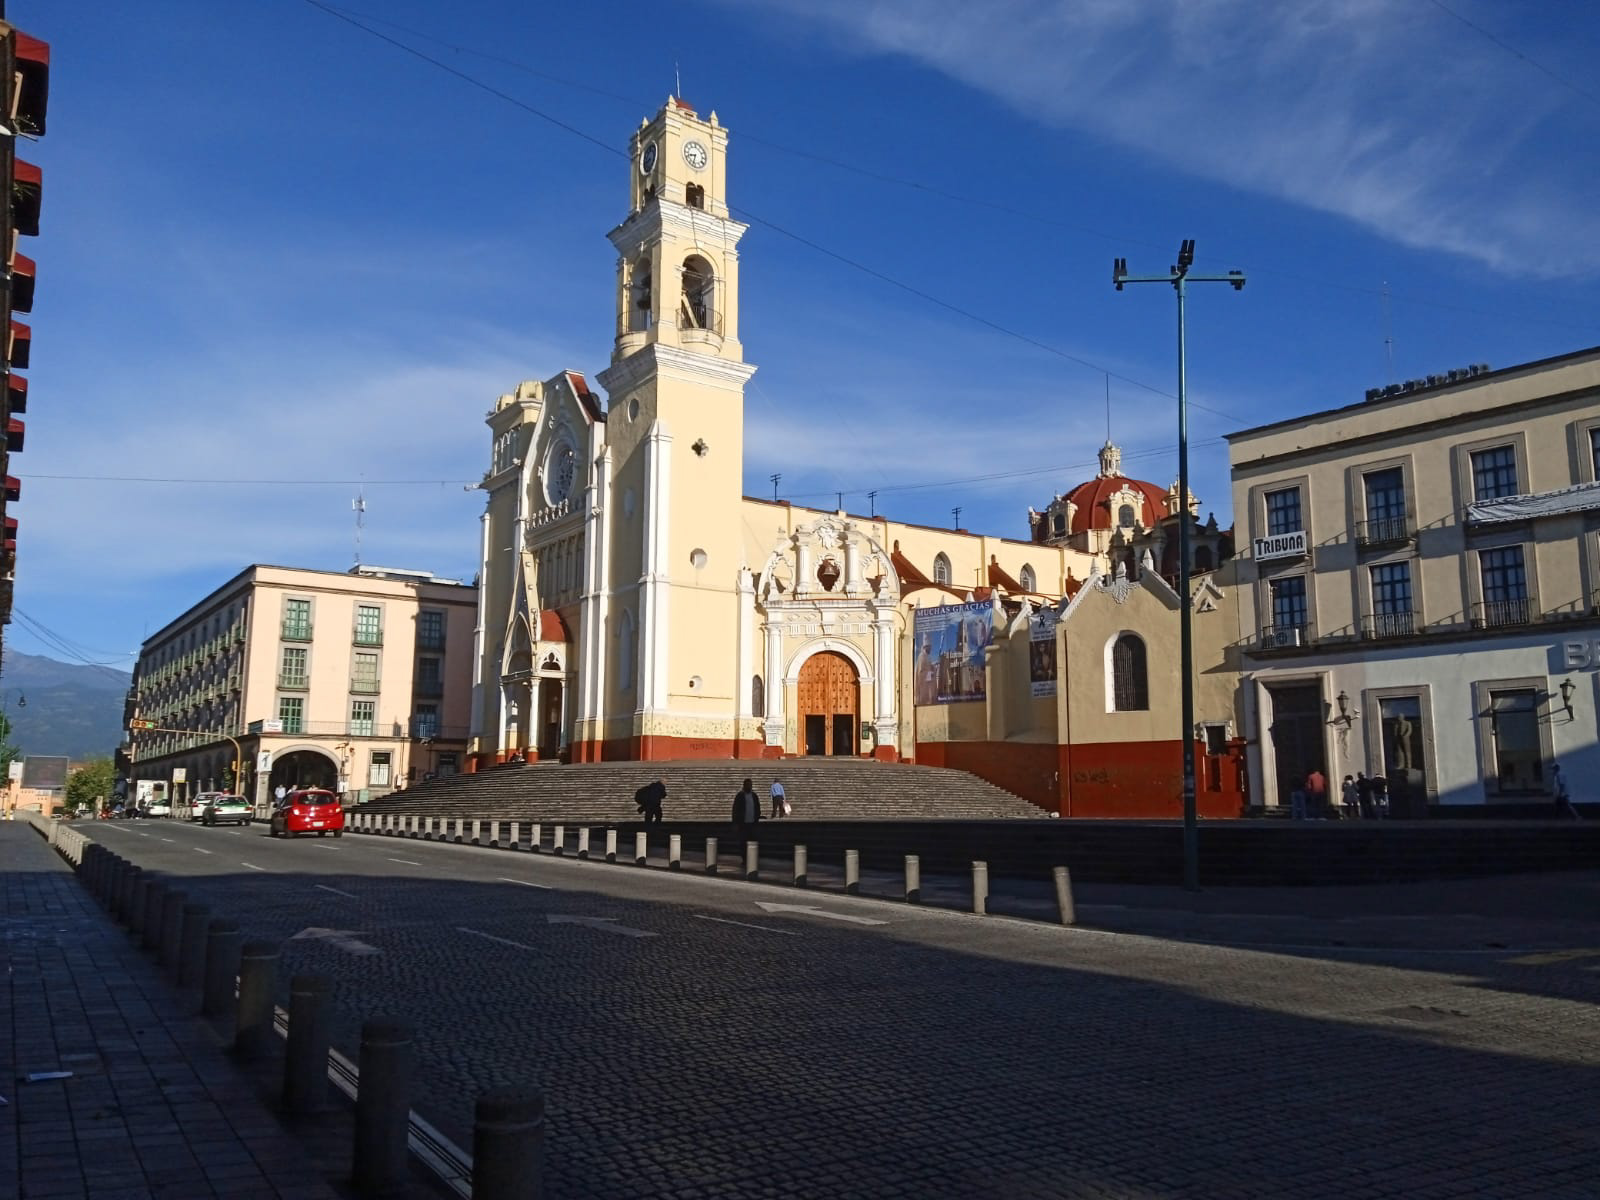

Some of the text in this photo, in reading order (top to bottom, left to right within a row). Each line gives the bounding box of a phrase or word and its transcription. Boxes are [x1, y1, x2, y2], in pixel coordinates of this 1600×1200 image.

[1255, 535, 1303, 556] TRIBUNA
[917, 607, 951, 617] MUCHAS
[1563, 640, 1600, 669] B
